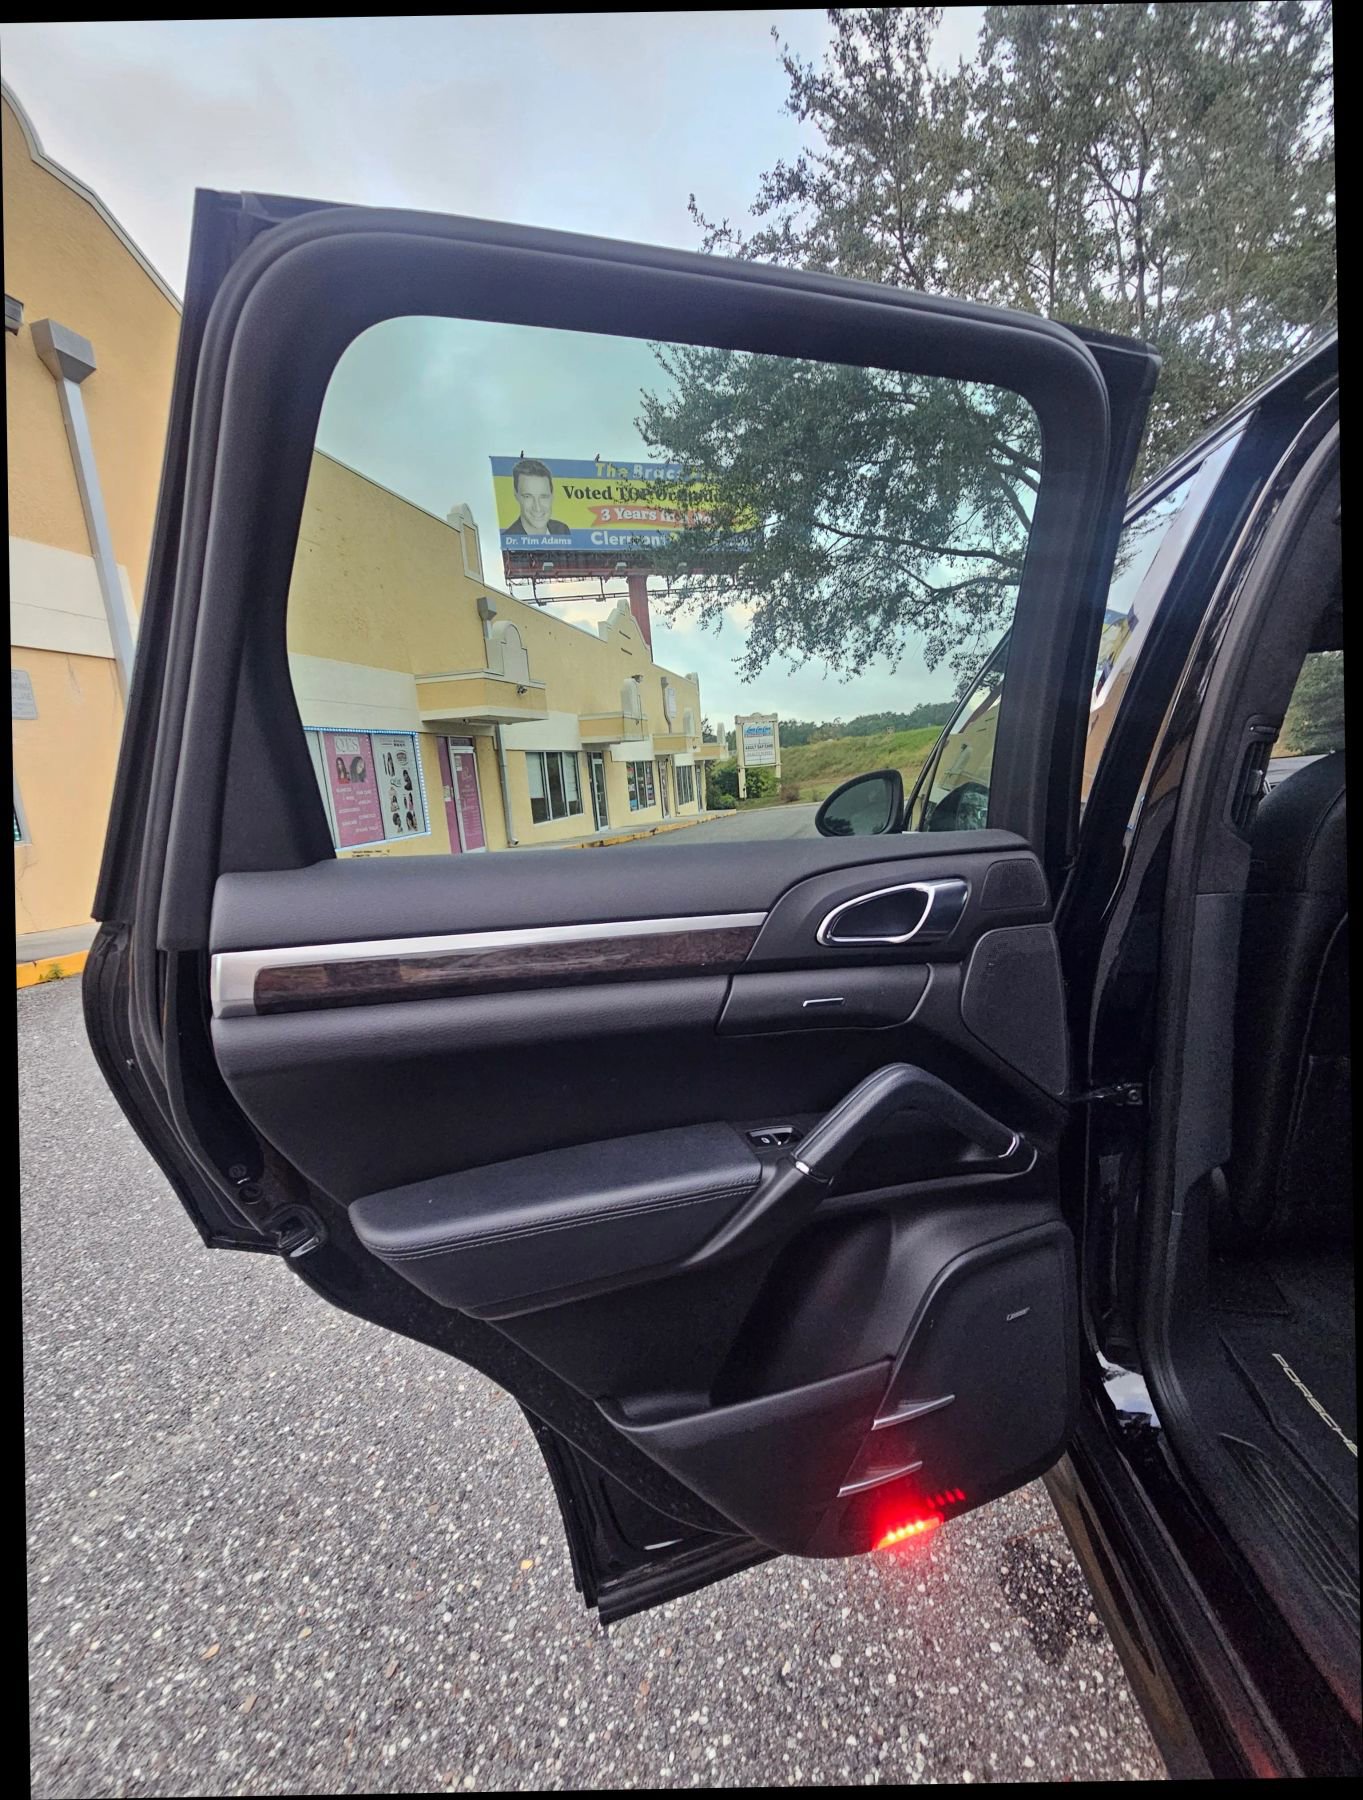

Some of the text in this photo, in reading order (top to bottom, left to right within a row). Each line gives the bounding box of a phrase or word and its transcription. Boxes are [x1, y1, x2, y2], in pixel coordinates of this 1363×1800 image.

[595, 463, 628, 479] The
[562, 485, 613, 501] Voted
[600, 508, 611, 521] 3
[615, 507, 657, 521] Years
[505, 536, 572, 546] Dr. Tim Adams
